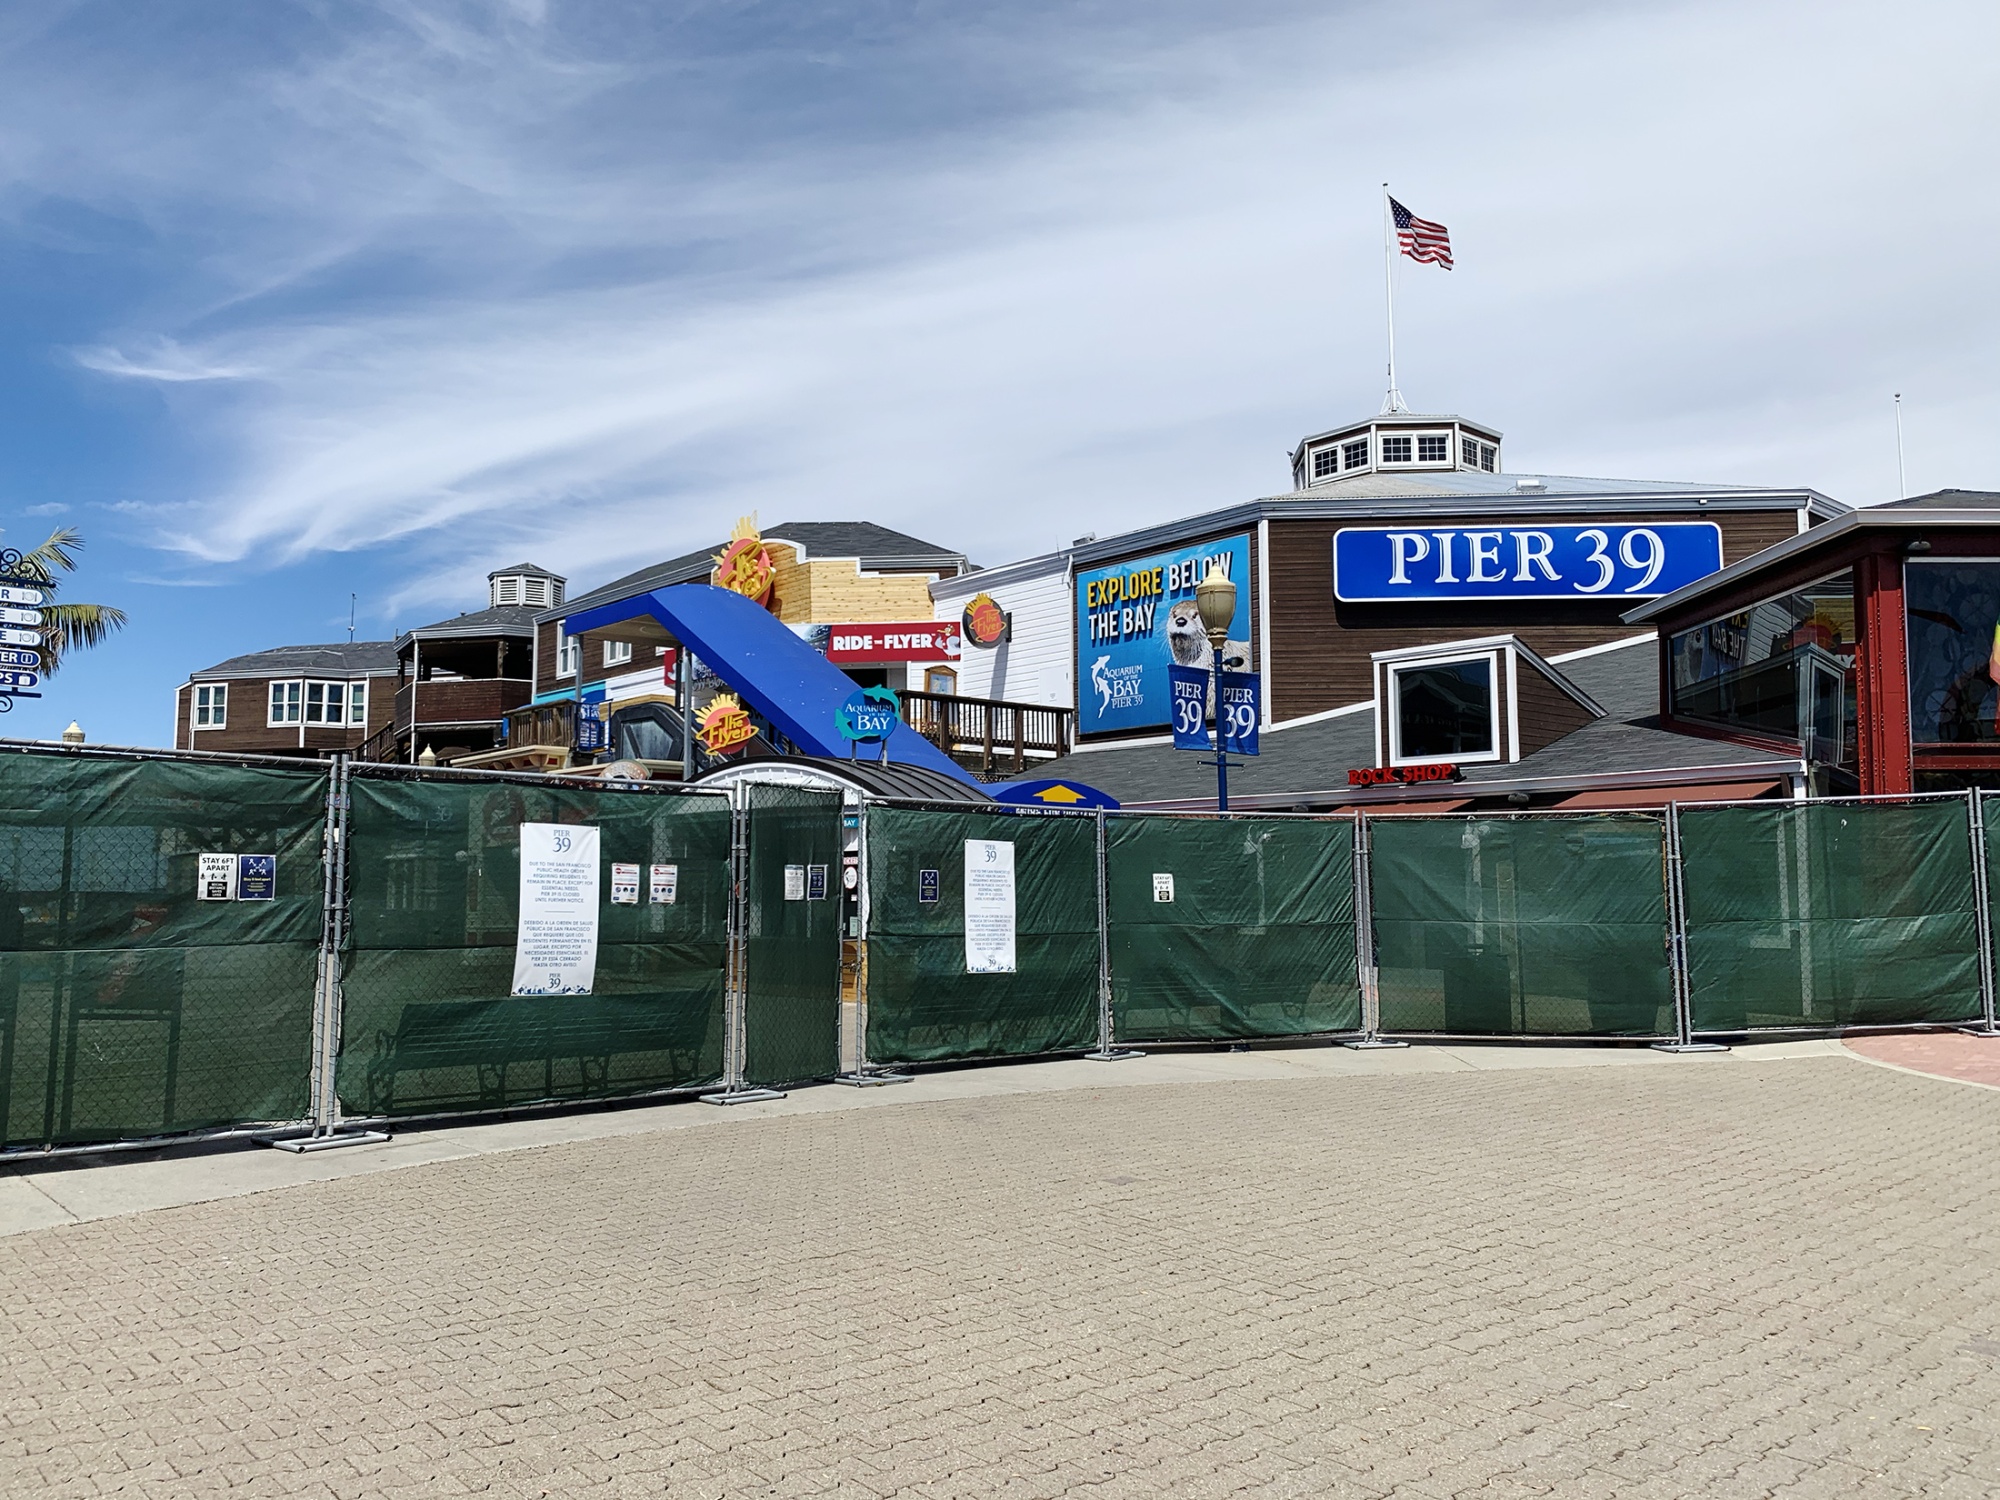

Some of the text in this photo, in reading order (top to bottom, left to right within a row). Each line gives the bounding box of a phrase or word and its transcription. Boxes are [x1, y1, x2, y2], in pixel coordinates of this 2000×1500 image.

[1386, 528, 1665, 593] PIER 39
[1087, 567, 1163, 608] EXPLORE
[972, 617, 1003, 637] Flyer
[1088, 602, 1155, 640] THE BAY
[833, 635, 872, 651] RIDE
[884, 633, 933, 649] FLYER
[1102, 664, 1142, 680] AQUARIUM
[1112, 678, 1142, 698] BAY
[1174, 681, 1202, 699] PIER
[1223, 687, 1254, 704] PIER
[844, 703, 892, 715] AQUARIUM
[1112, 696, 1144, 709] PIER 39
[719, 712, 747, 730] The
[858, 715, 890, 730] BAY
[1175, 698, 1202, 735] 39
[1224, 704, 1256, 739] 39
[700, 724, 757, 750] Flyer
[1348, 764, 1454, 786] ROCK SHOP
[552, 837, 571, 853] 39
[985, 850, 997, 862] 39
[548, 978, 561, 989] 39
